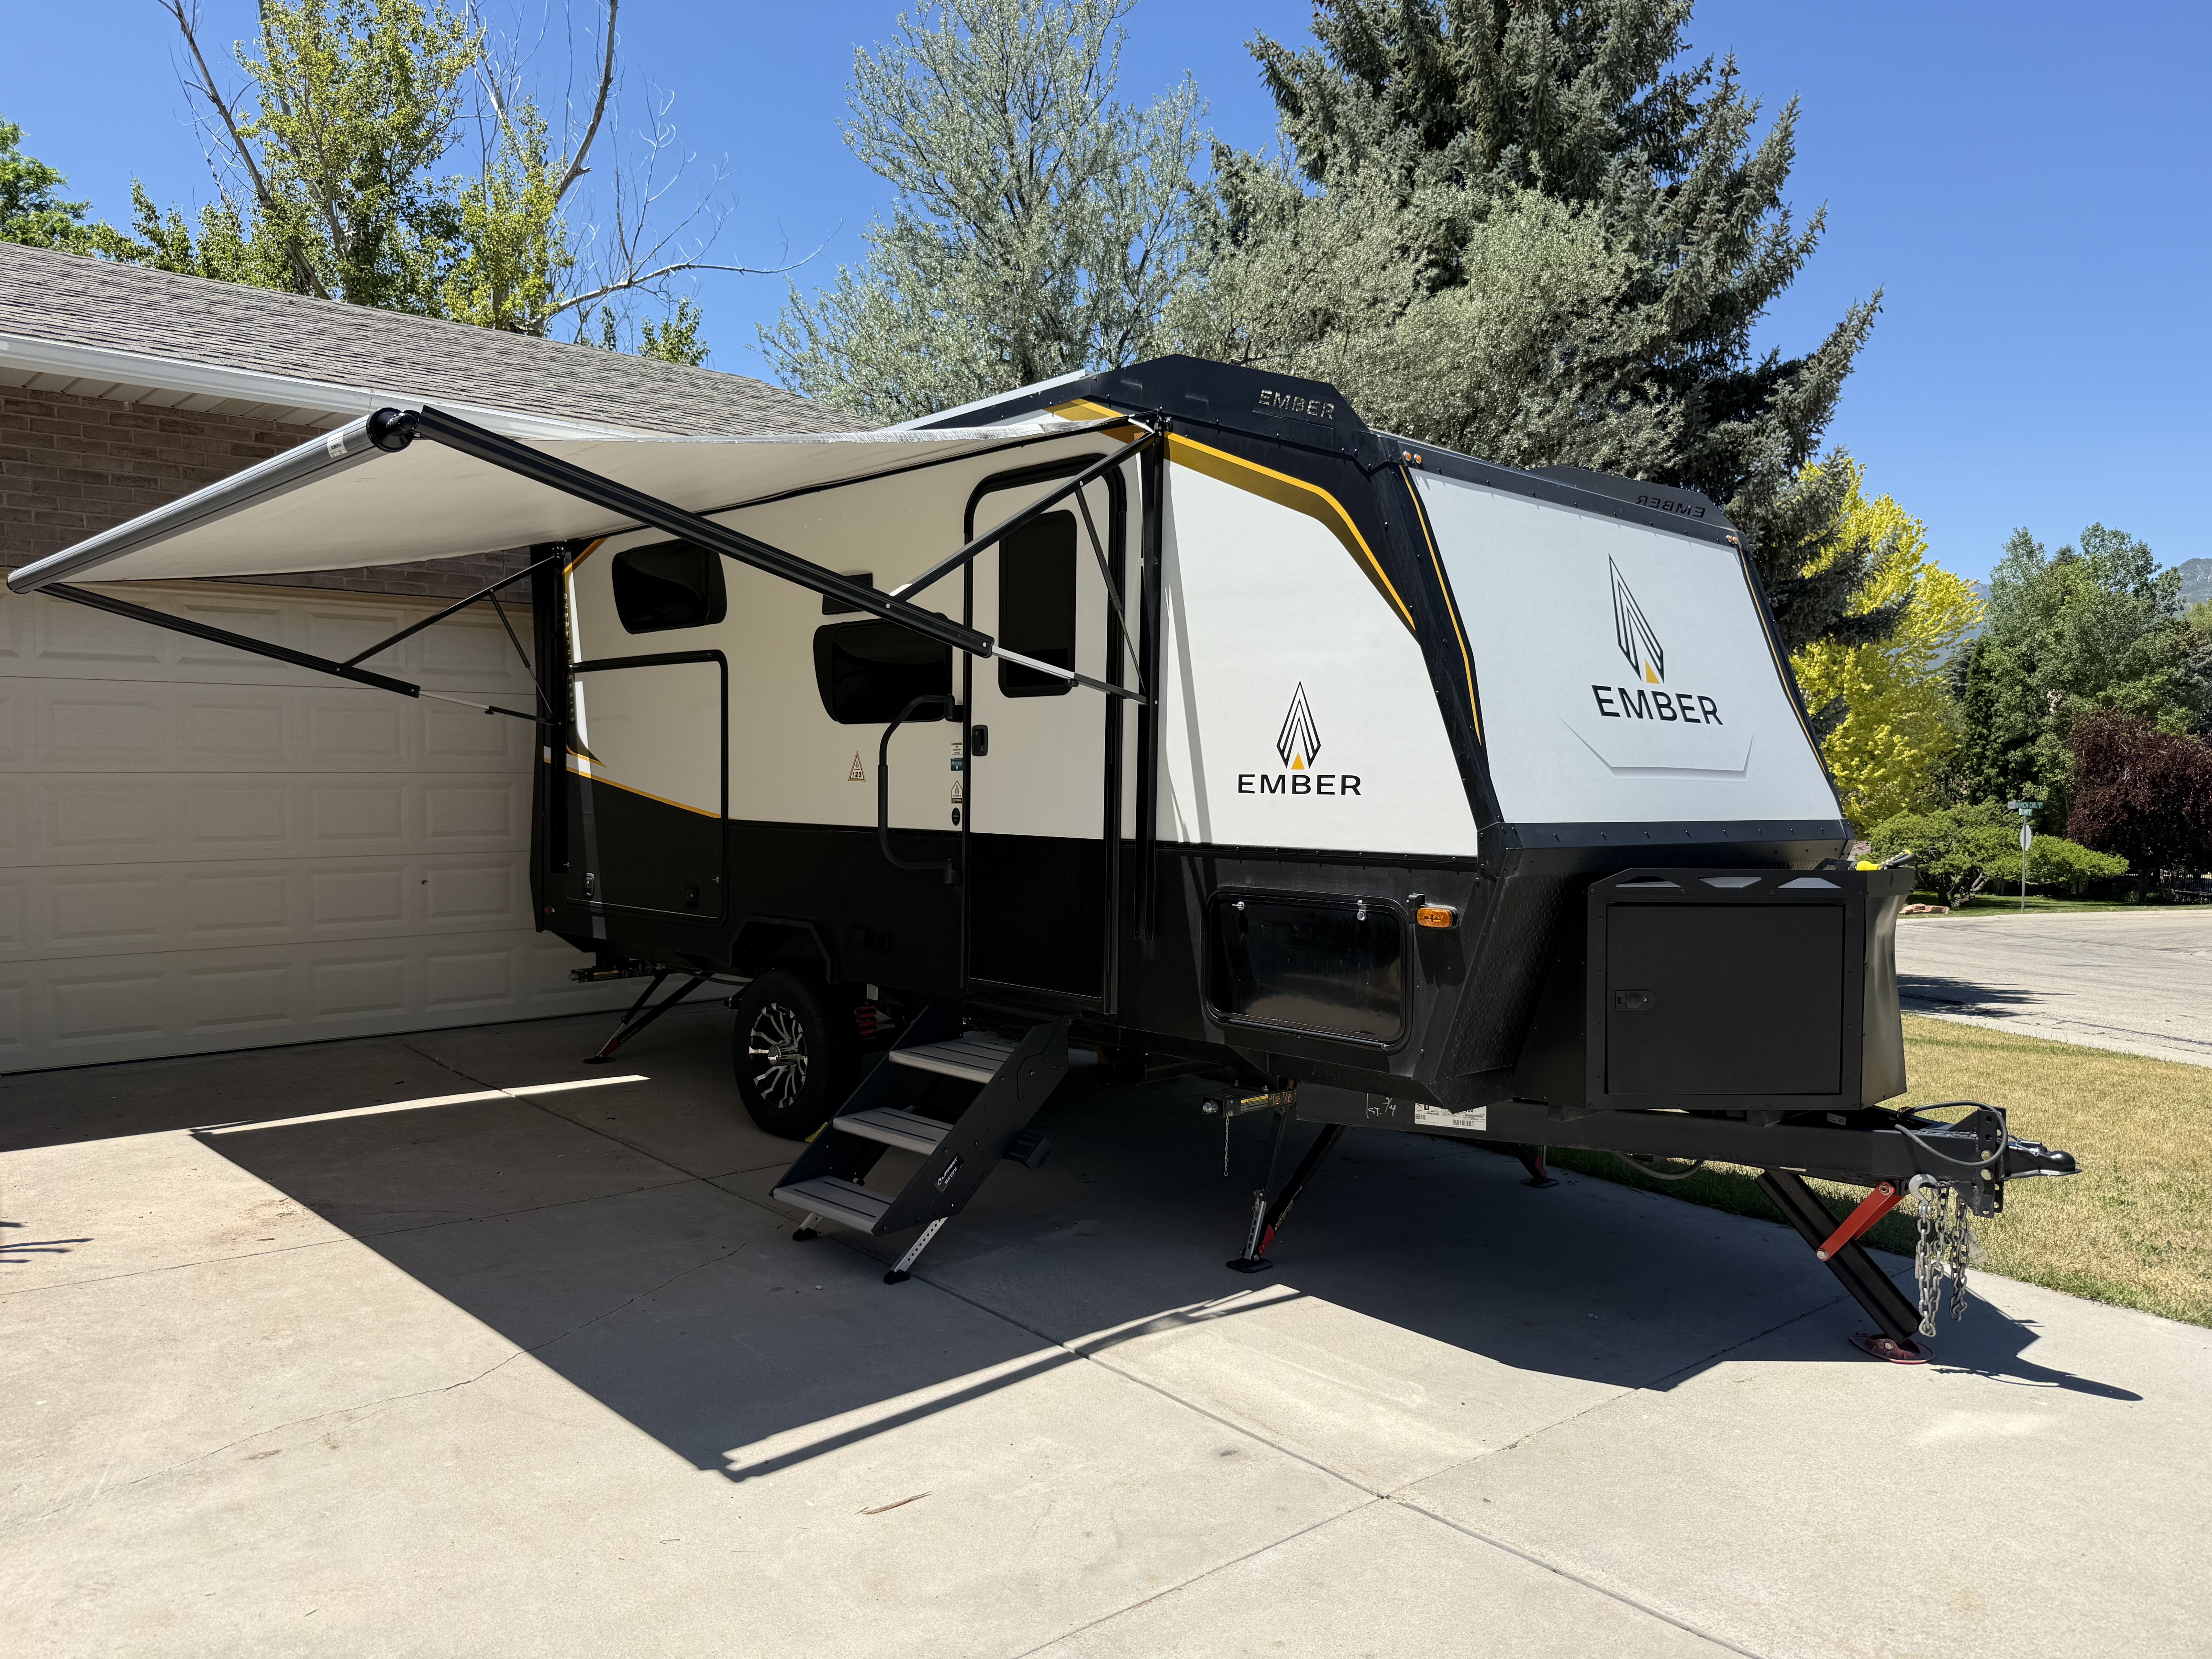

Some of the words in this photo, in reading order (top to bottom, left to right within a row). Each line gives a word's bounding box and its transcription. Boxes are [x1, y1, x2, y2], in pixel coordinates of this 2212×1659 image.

[1259, 389, 1334, 419] EMBER
[1591, 685, 1723, 725] EMBER
[1238, 774, 1361, 795] EMBER
[941, 1156, 958, 1180] LIPPERT
